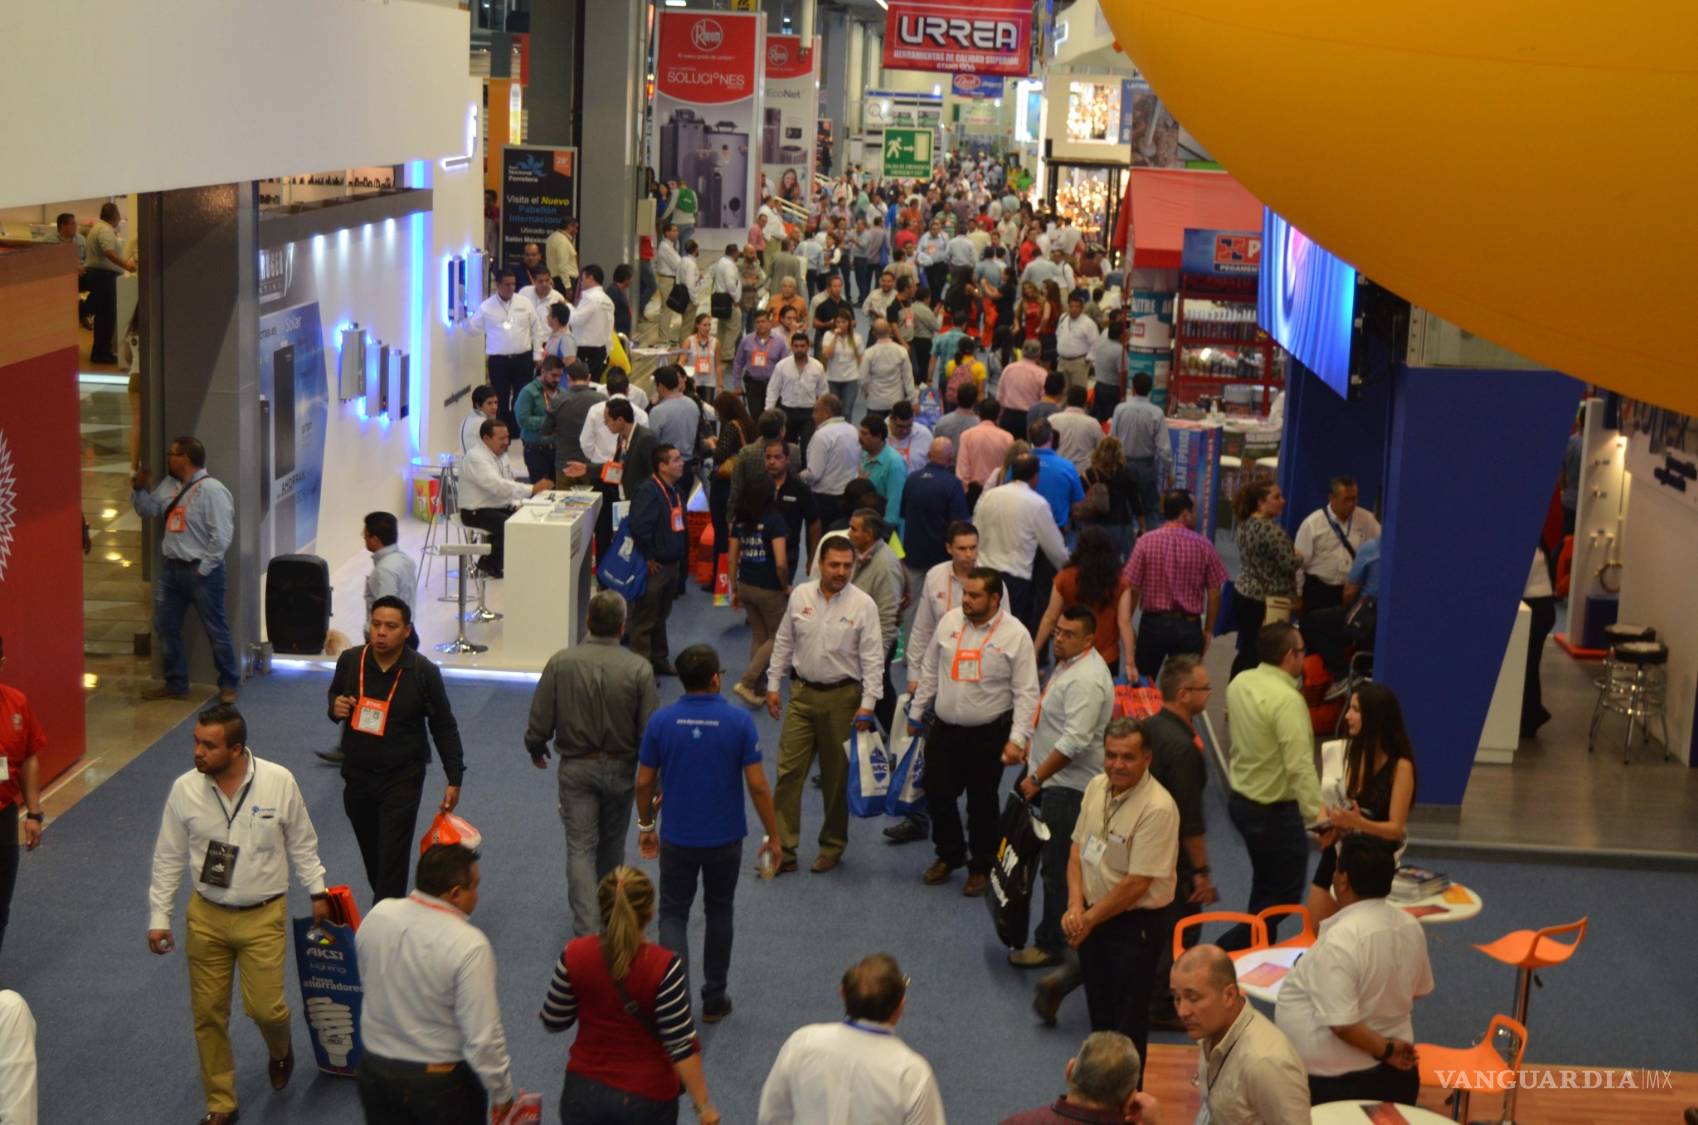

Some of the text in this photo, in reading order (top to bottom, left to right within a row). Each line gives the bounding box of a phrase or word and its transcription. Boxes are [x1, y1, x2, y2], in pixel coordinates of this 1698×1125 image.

[901, 15, 1018, 49] URREA
[894, 49, 1019, 65] HERRAMIENTAS DE CALIDAD SUPERIOR
[506, 195, 570, 206] Visita el Nuevo
